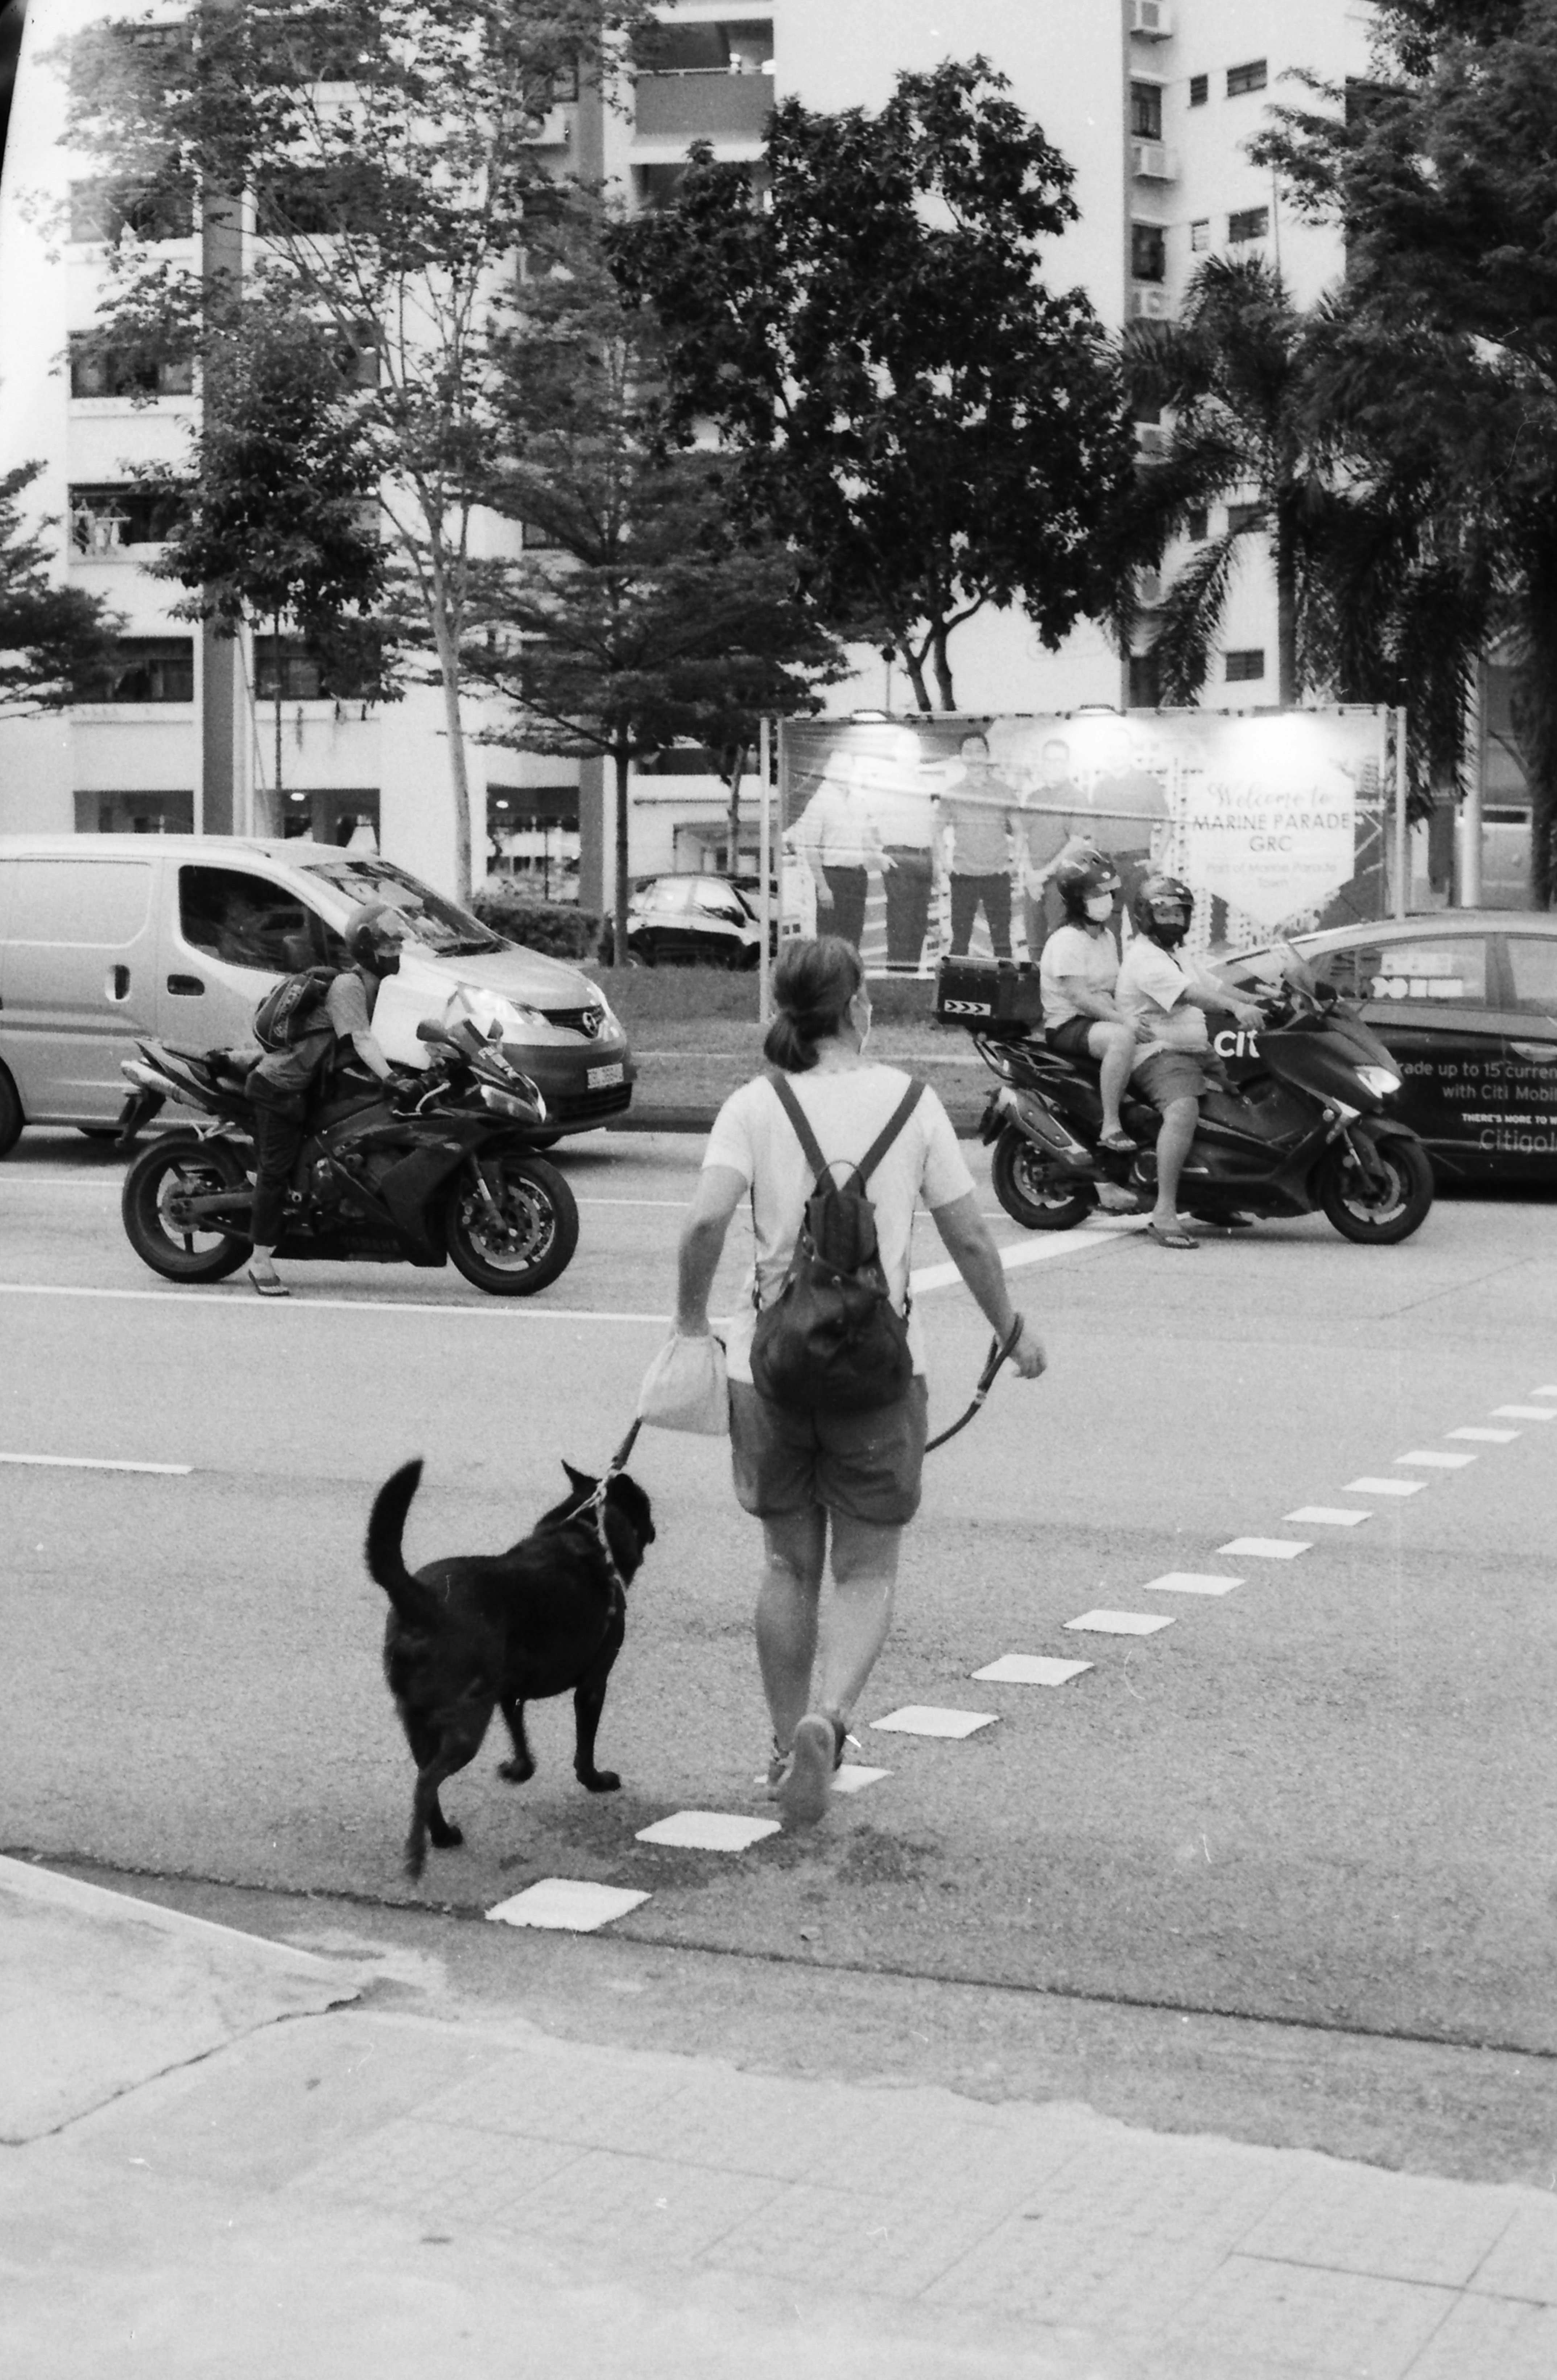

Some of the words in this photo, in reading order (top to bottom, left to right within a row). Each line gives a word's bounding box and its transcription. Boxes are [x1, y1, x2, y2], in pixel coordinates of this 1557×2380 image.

[1207, 781, 1304, 810] Welcome
[1310, 785, 1334, 807] to
[1193, 814, 1267, 830] MARINE
[1274, 813, 1350, 829] PARADE
[1250, 836, 1292, 851] GRC
[1438, 1064, 1458, 1078] up
[1463, 1062, 1479, 1076] to
[1484, 1064, 1500, 1077] 15
[1442, 1084, 1476, 1098] with
[1481, 1085, 1508, 1100] Citi
[1461, 1113, 1502, 1122] THERE'S
[1505, 1114, 1532, 1124] MORE
[1535, 1116, 1547, 1124] TO
[1480, 1129, 1557, 1154] Citigol
